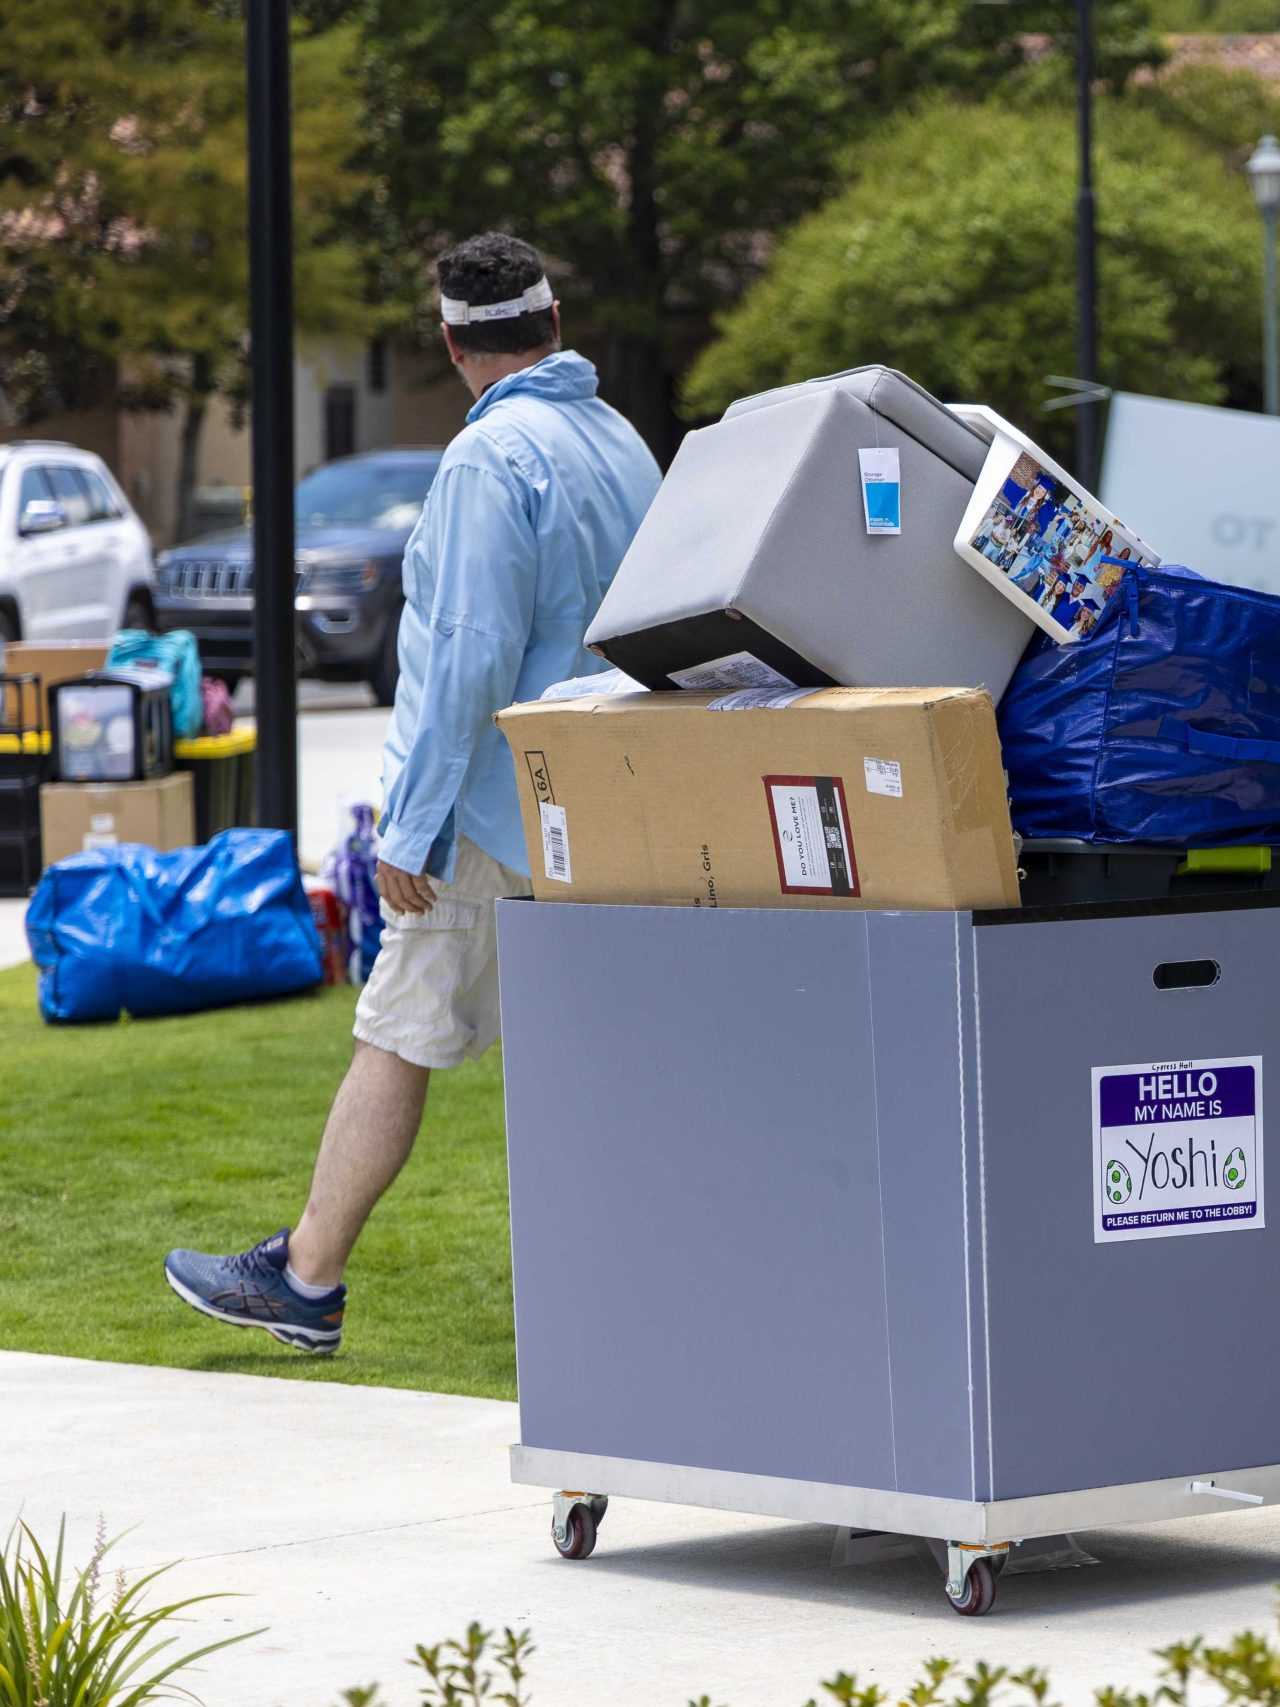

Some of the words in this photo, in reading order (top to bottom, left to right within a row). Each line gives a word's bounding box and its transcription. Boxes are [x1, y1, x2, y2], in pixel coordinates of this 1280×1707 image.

[534, 767, 548, 791] 6A
[790, 796, 798, 814] ME?
[793, 815, 802, 838] LOVE
[700, 844, 711, 872] Gris
[797, 841, 805, 861] YOU
[800, 863, 807, 876] DO
[1179, 1061, 1193, 1070] Hall
[1138, 1071, 1218, 1102] HELLO
[1134, 1105, 1158, 1122] MY
[1162, 1101, 1205, 1120] NAME
[1209, 1099, 1222, 1116] IS
[1125, 1132, 1218, 1200] Yoshi
[1107, 1214, 1139, 1227] PLEASE
[1140, 1212, 1175, 1224] RETURN
[1176, 1211, 1189, 1220] ME
[1191, 1209, 1203, 1219] TO
[1204, 1207, 1221, 1218] THE
[1222, 1205, 1252, 1217] LOBBY!
